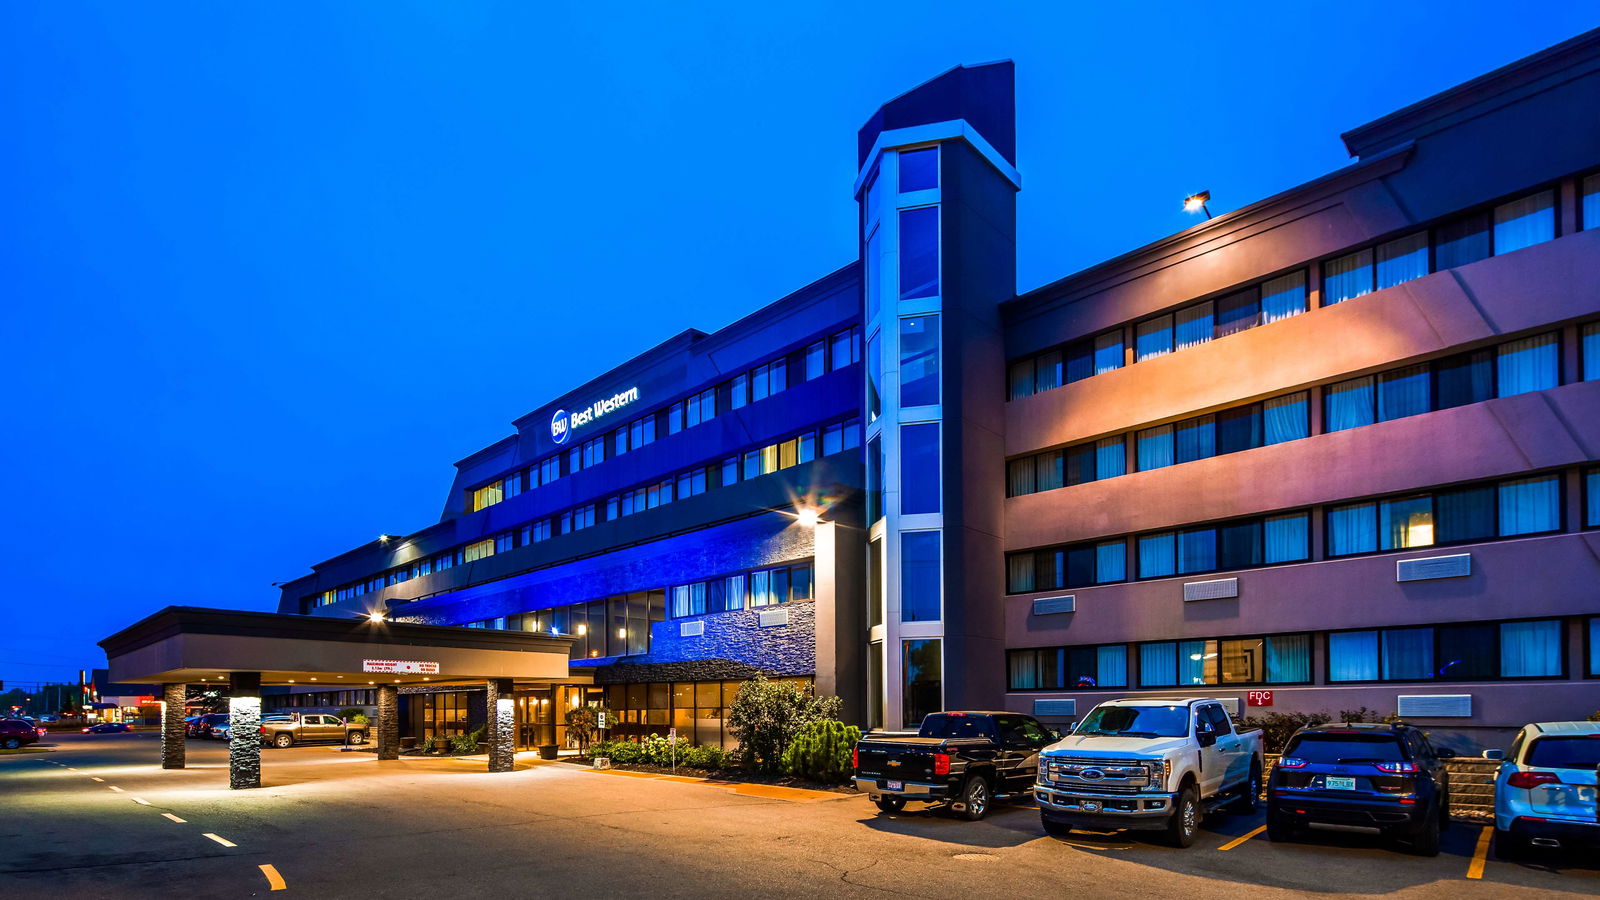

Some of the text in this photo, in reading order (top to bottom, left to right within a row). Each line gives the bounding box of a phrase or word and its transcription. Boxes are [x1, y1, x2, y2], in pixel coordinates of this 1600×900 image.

[571, 387, 638, 428] Best Western
[552, 417, 567, 436] BW
[1249, 691, 1270, 700] FDC
